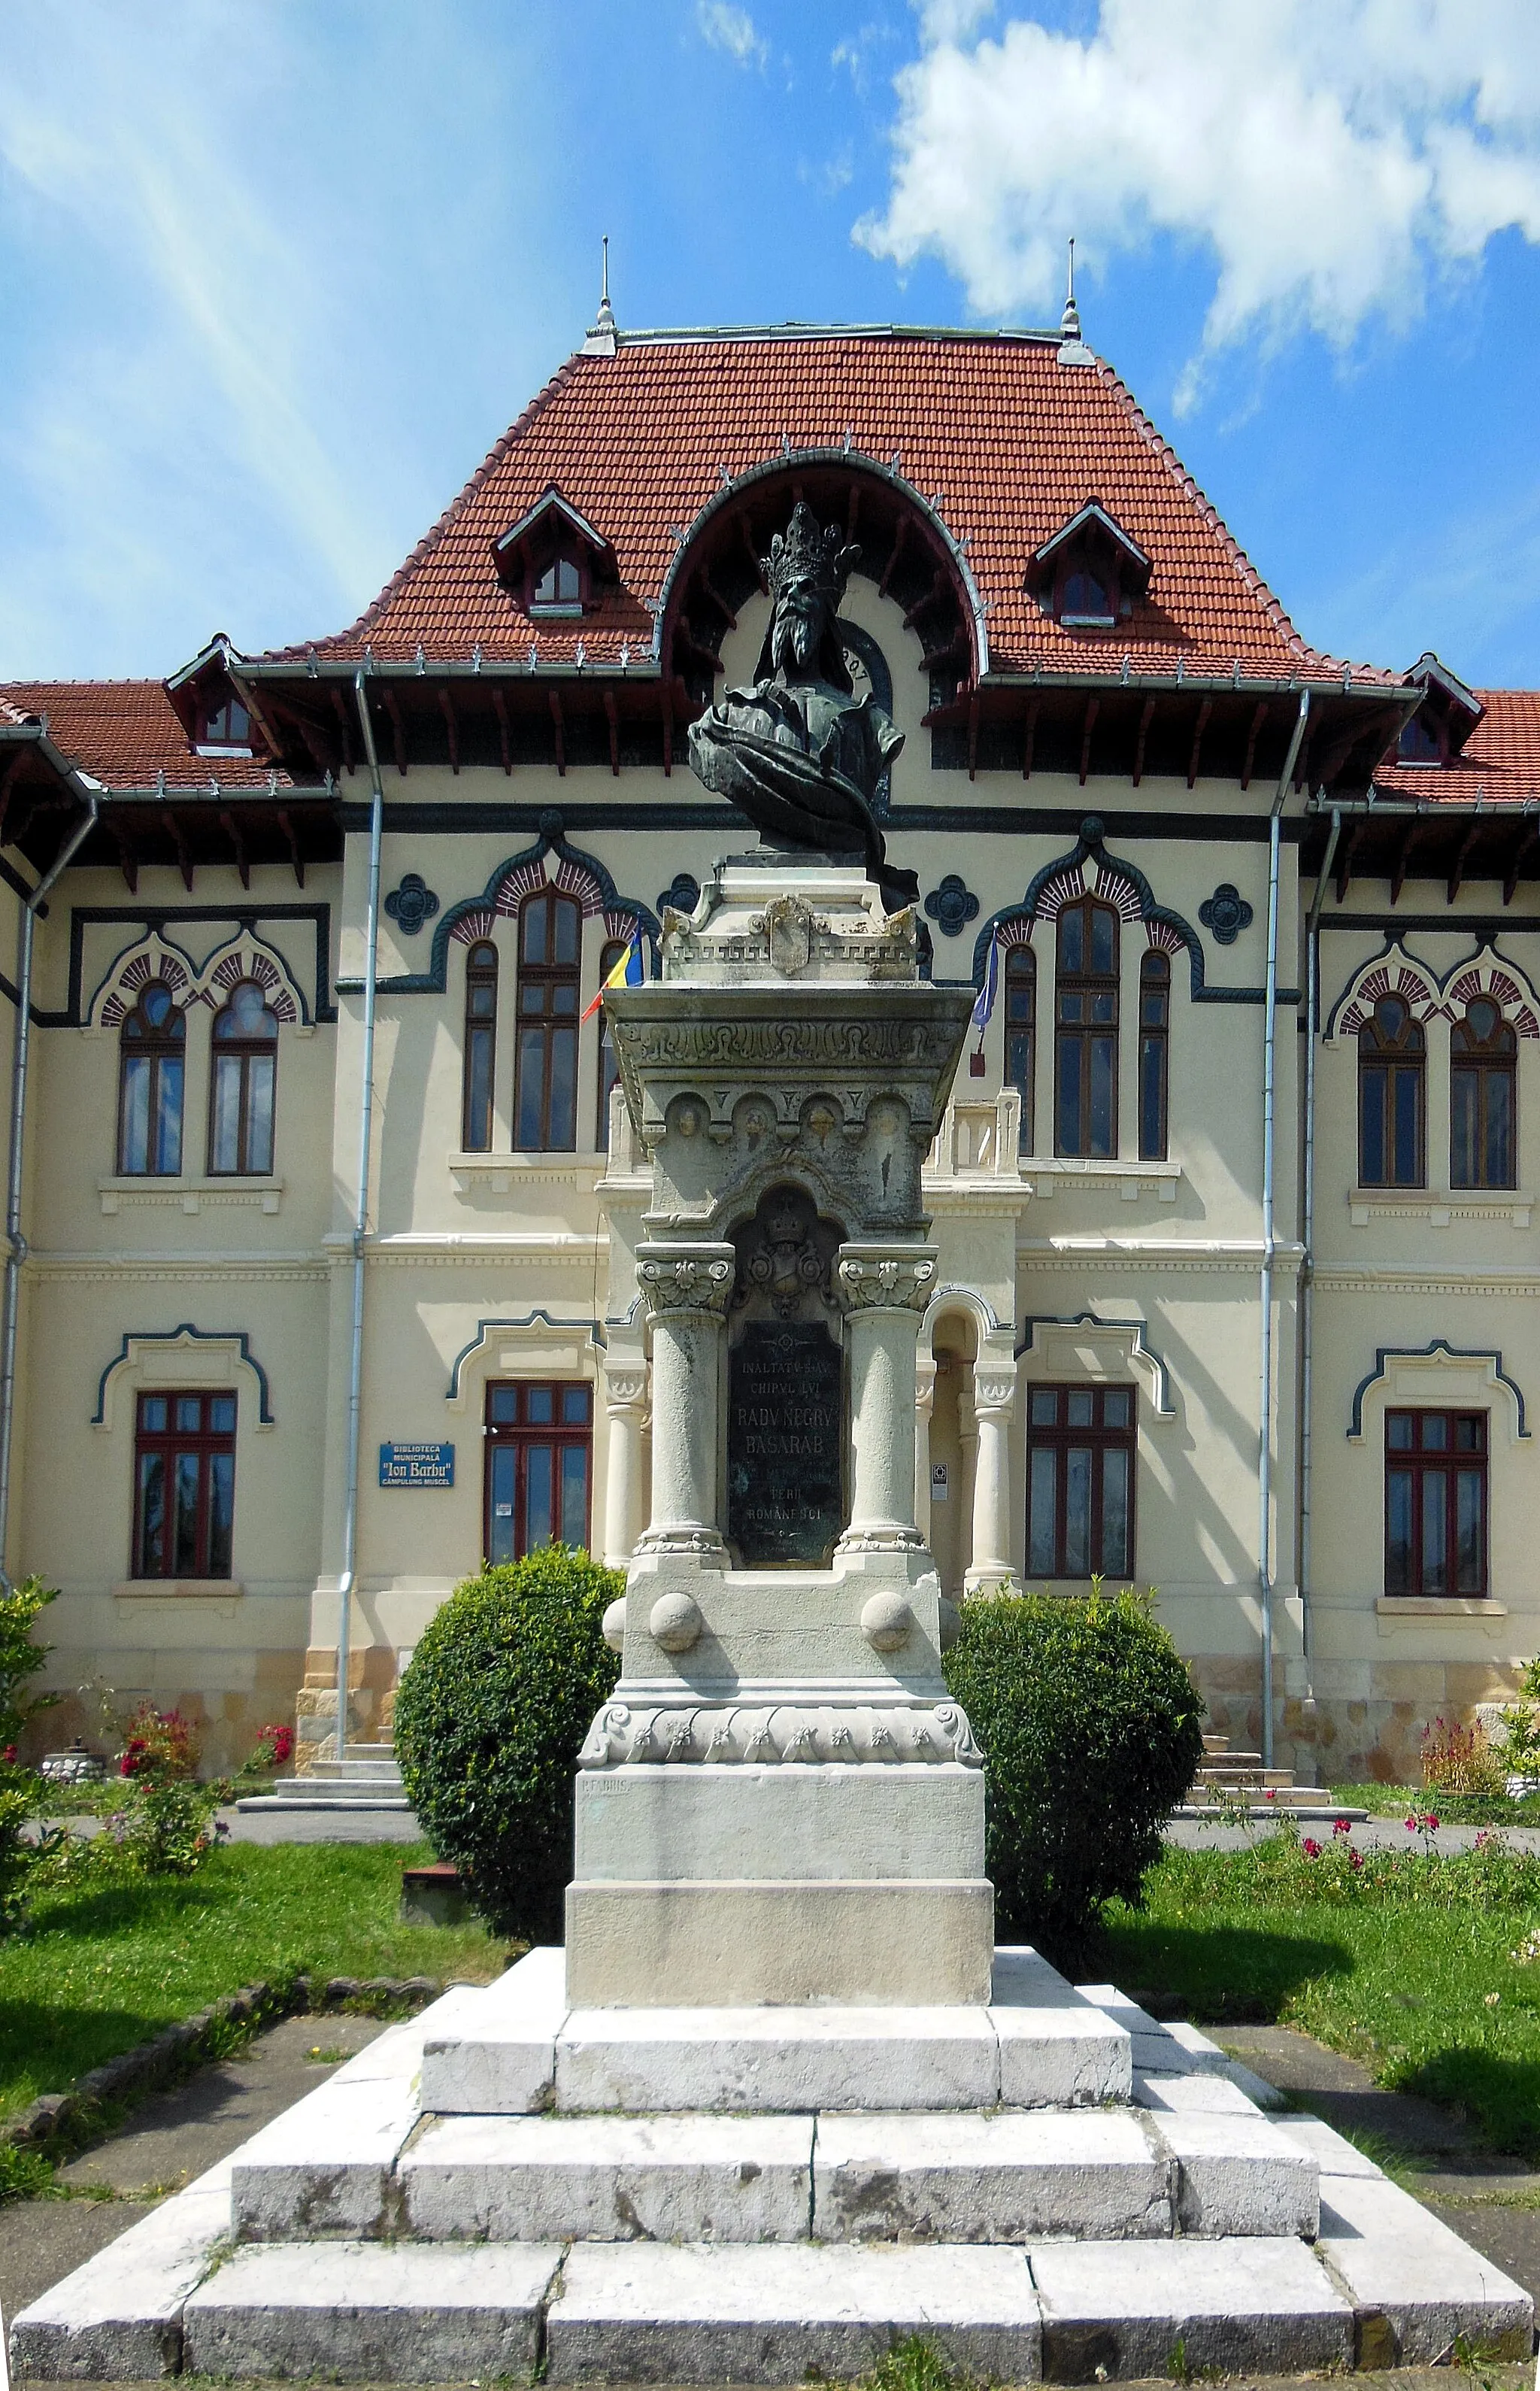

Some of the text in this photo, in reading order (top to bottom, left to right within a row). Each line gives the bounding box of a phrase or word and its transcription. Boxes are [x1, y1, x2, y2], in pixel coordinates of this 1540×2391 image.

[751, 1382, 795, 1394] CHIPVL
[738, 1407, 832, 1426] RADV NEGRV
[746, 1435, 823, 1454] BASARAB
[383, 1462, 451, 1476] "Ion Barbu"
